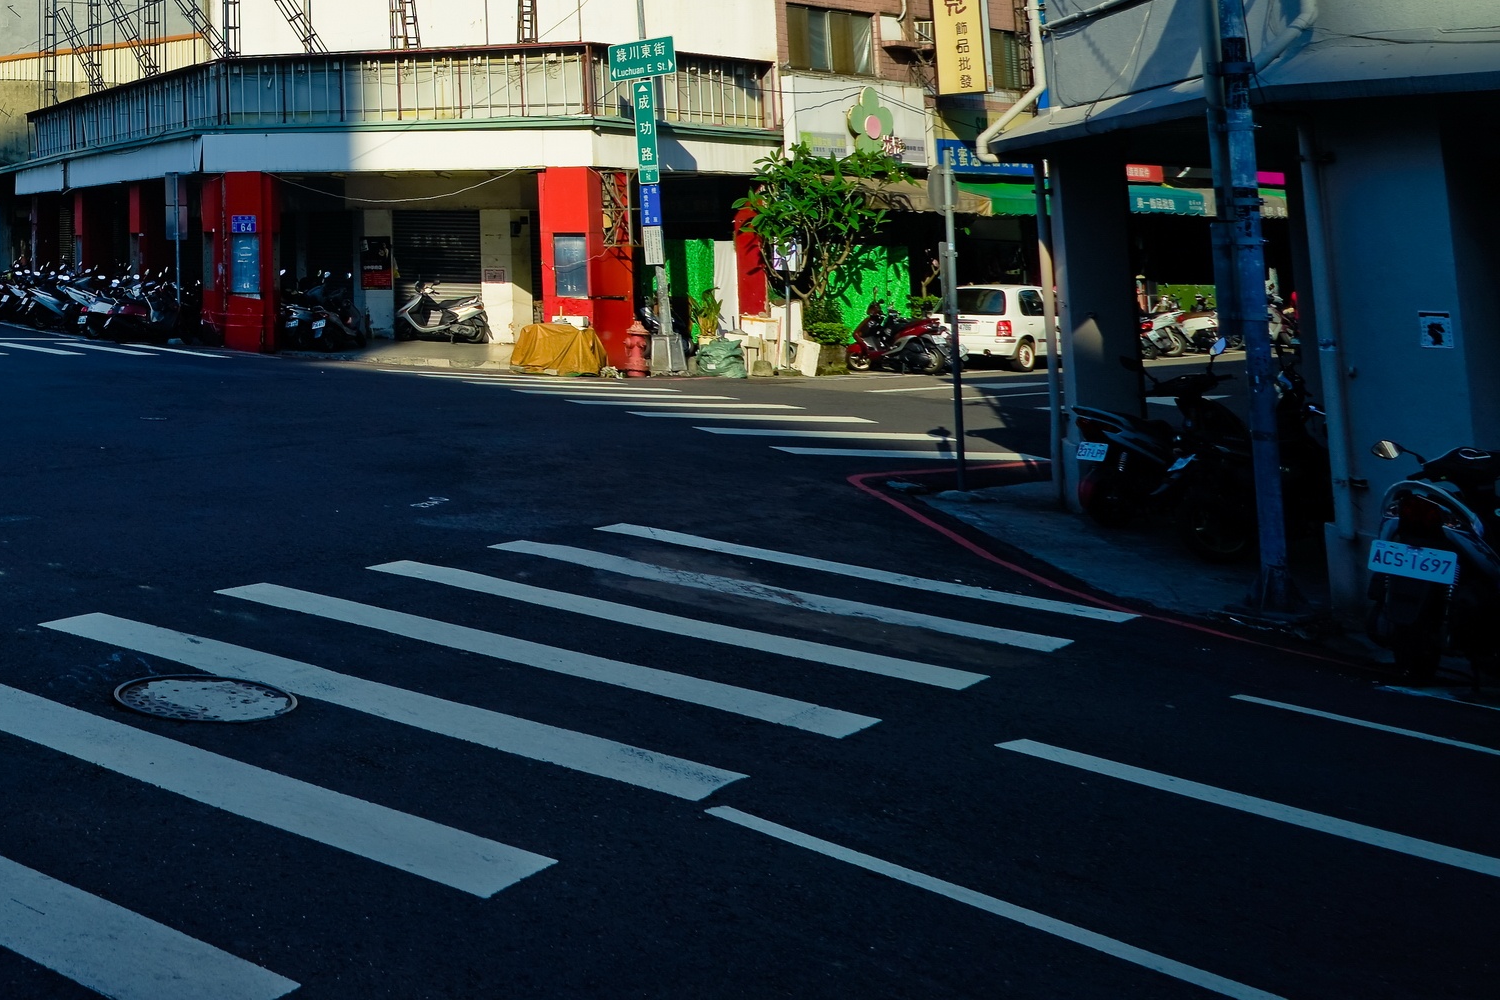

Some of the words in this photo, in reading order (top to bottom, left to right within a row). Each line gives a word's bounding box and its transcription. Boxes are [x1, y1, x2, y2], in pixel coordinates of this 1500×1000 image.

[616, 42, 665, 63] 綠川東街
[955, 21, 972, 89] 飾品批發
[617, 67, 644, 77] Luchuan
[647, 64, 654, 73] E.
[657, 62, 667, 71] St.
[638, 95, 653, 161] 成功路
[241, 223, 252, 232] 64
[1372, 549, 1452, 575] ACS-1697
